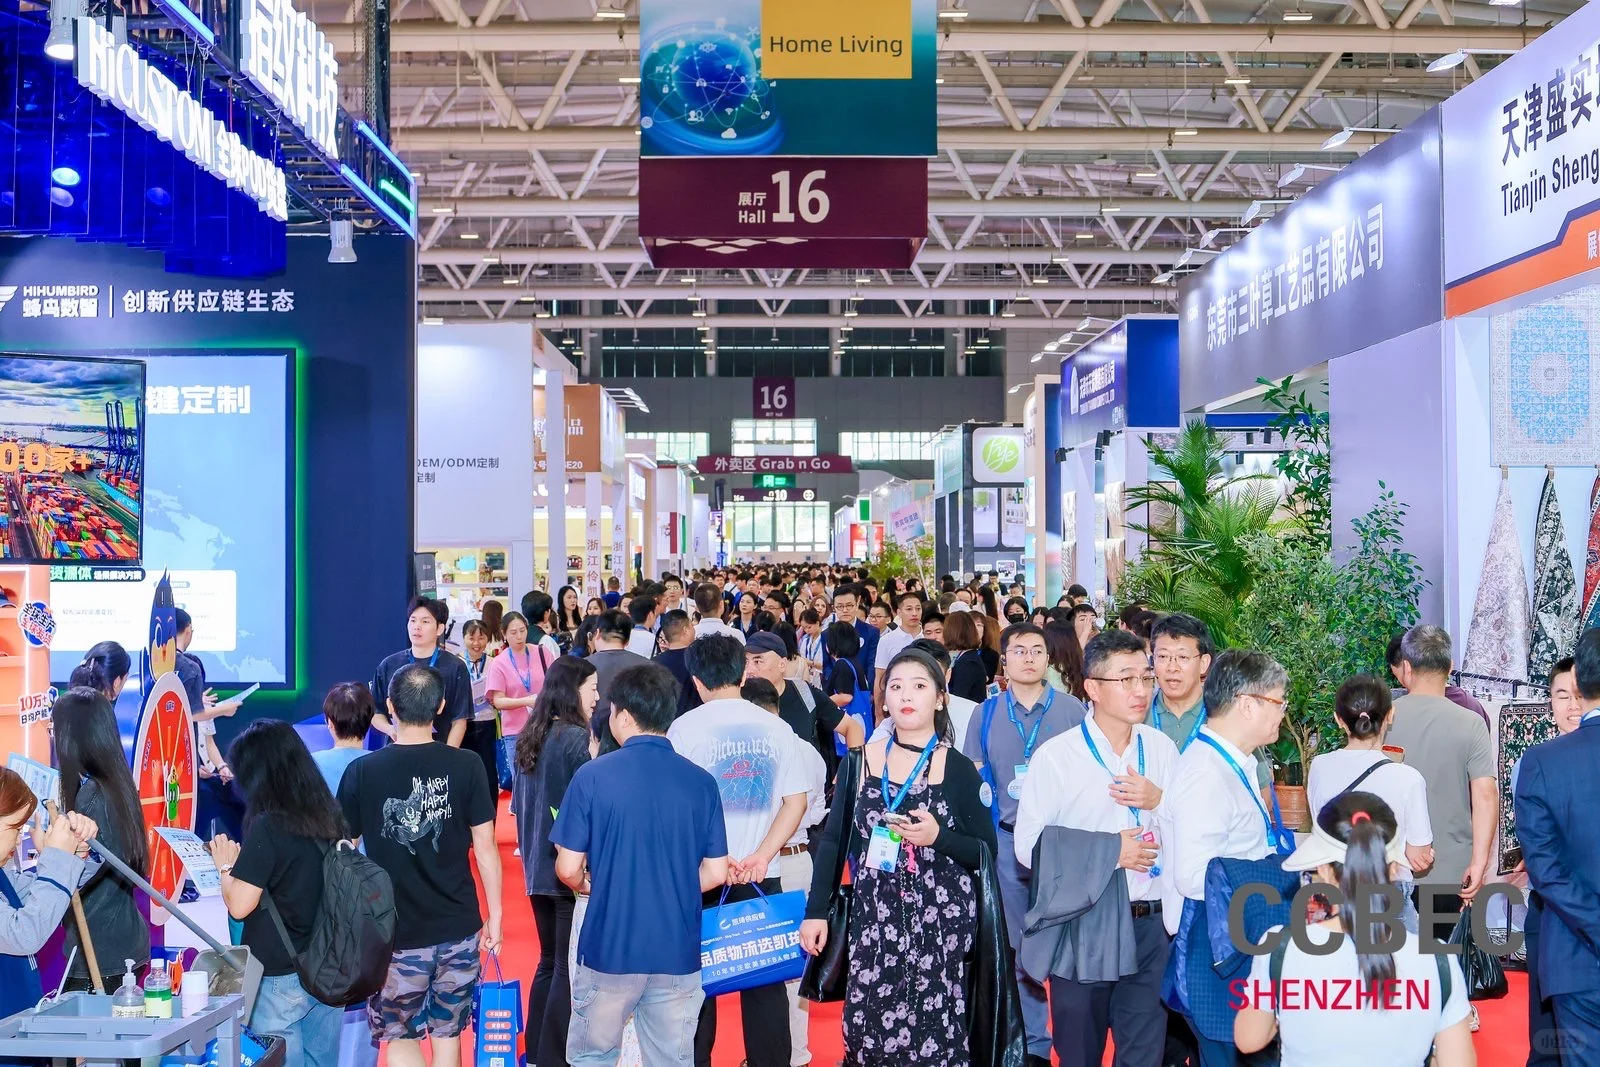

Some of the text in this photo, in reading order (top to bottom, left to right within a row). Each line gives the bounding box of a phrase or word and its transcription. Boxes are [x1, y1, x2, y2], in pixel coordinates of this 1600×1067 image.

[770, 36, 903, 57] Home Living
[1502, 43, 1600, 166] 天津盛实
[1501, 148, 1599, 217] Tianjin Sheng
[738, 170, 830, 223] 展厅 16
[738, 211, 766, 223] Hall
[1207, 203, 1384, 351] 东莞市三叶草工艺品有限公司
[23, 285, 98, 297] HIHUMBIRD
[122, 289, 295, 314] 创新供应链生态
[22, 298, 98, 318] 蜂鸟数智
[145, 385, 251, 414] 键定制
[760, 385, 787, 410] 16
[715, 457, 831, 471] 外卖区 Grab n Go
[426, 775, 449, 794] HAPPY
[421, 791, 449, 812] HAPPY
[426, 803, 453, 823] HAPPY!!
